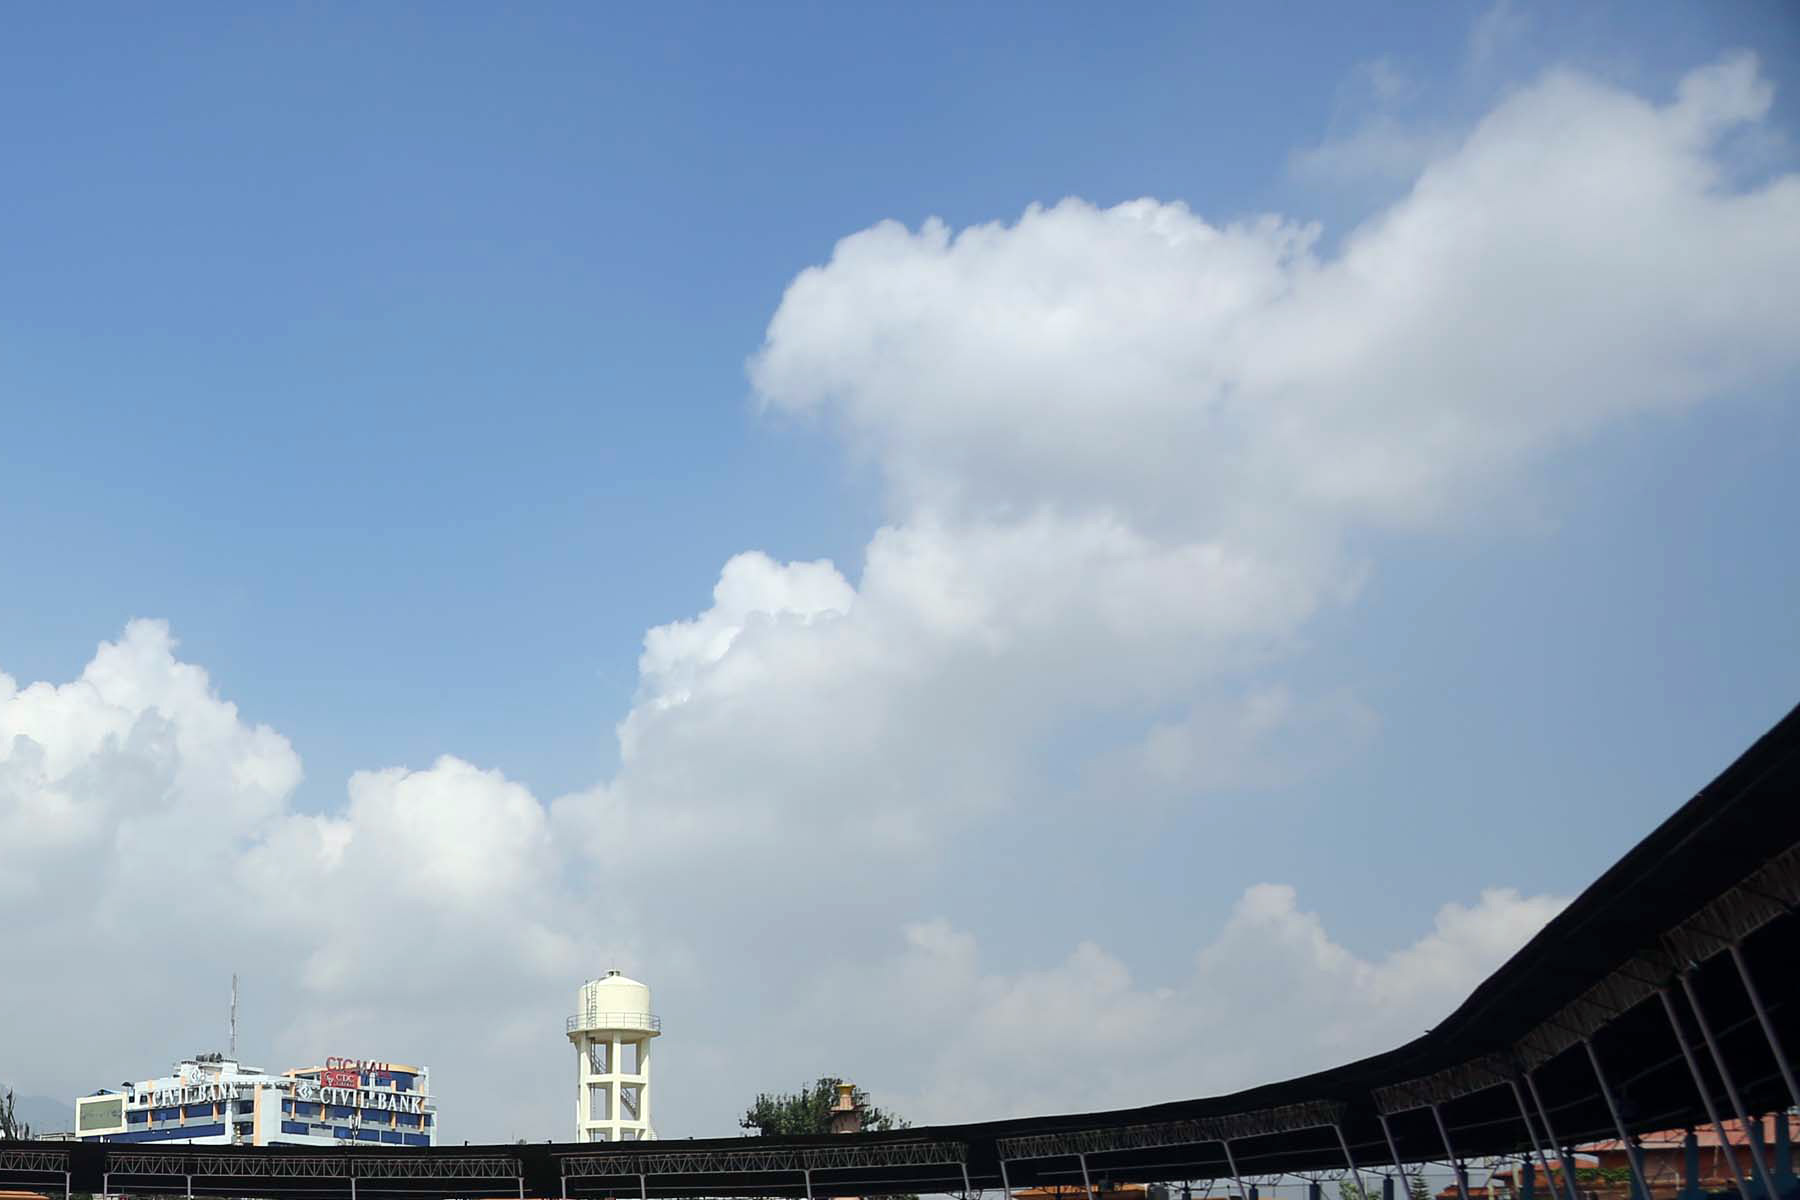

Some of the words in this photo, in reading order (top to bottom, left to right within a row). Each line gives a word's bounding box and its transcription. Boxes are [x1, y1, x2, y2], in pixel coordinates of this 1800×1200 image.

[152, 1087, 194, 1107] CIVIL
[199, 1082, 239, 1104] BANK
[320, 1087, 369, 1109] CIVIL
[378, 1092, 422, 1114] BANK
